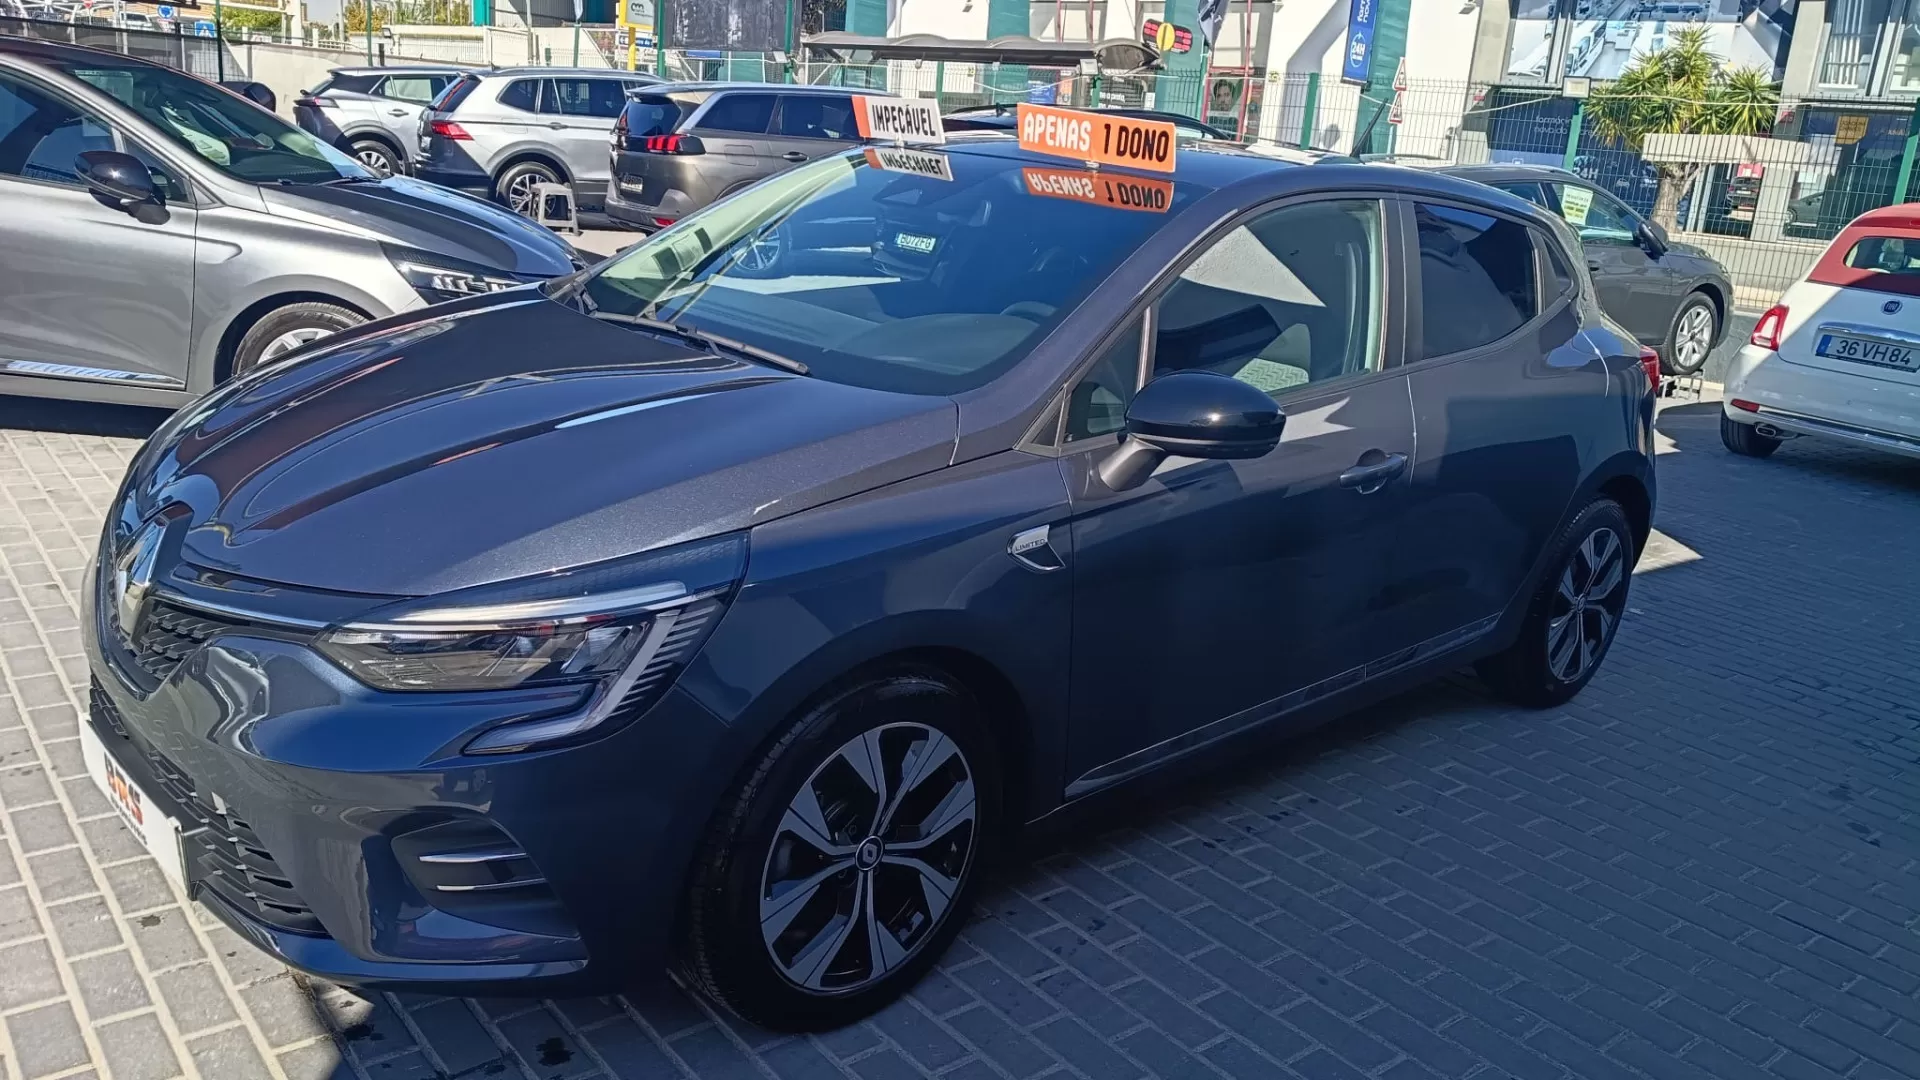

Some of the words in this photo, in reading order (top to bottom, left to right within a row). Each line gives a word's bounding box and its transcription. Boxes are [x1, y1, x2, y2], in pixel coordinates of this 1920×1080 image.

[871, 104, 936, 137] IMPECÁVEL
[1023, 112, 1092, 151] APENAS
[1104, 123, 1112, 154] 1
[1116, 125, 1170, 162] DONO
[1573, 166, 1599, 179] 24H
[1015, 539, 1046, 551] LIMITED
